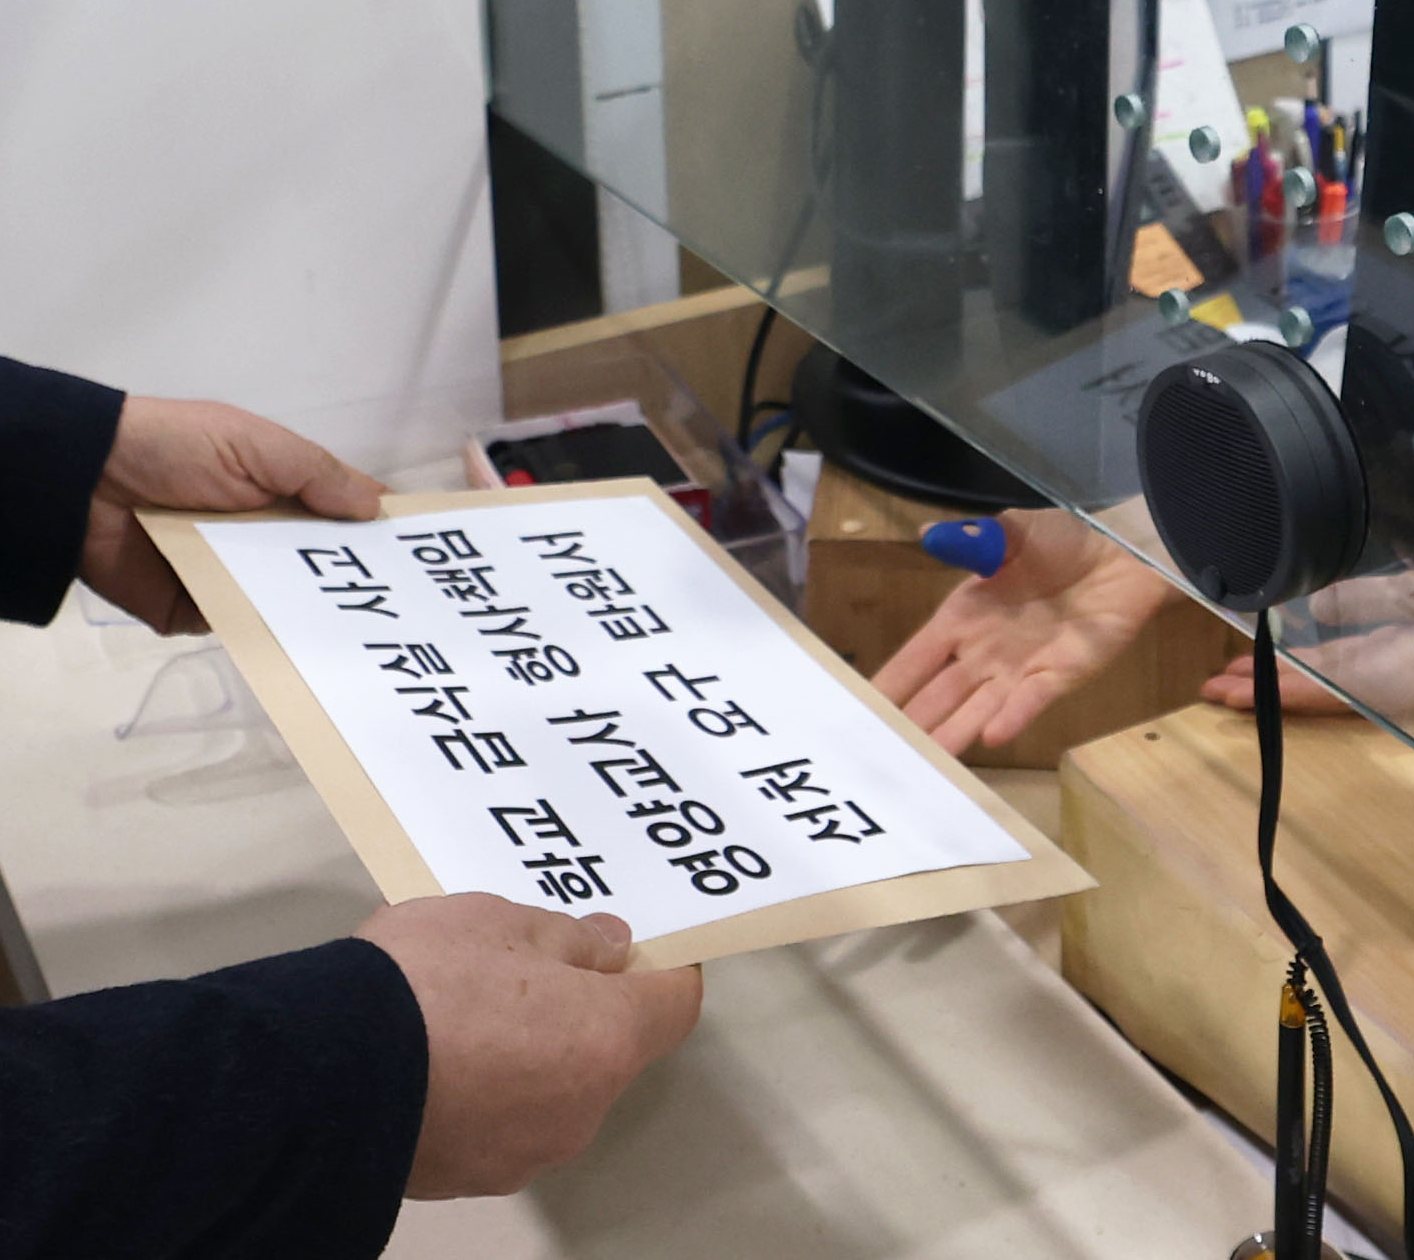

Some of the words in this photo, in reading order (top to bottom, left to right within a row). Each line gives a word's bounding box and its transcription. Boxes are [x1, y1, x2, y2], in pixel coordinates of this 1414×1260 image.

[296, 546, 400, 619] 사고
[397, 530, 585, 686] 형사책임
[519, 531, 673, 641] 탄원서
[363, 643, 528, 774] 급식실
[642, 663, 770, 738] 요구
[487, 799, 613, 903] 학교
[545, 709, 777, 899] 영양교사
[738, 758, 886, 844] 선처
